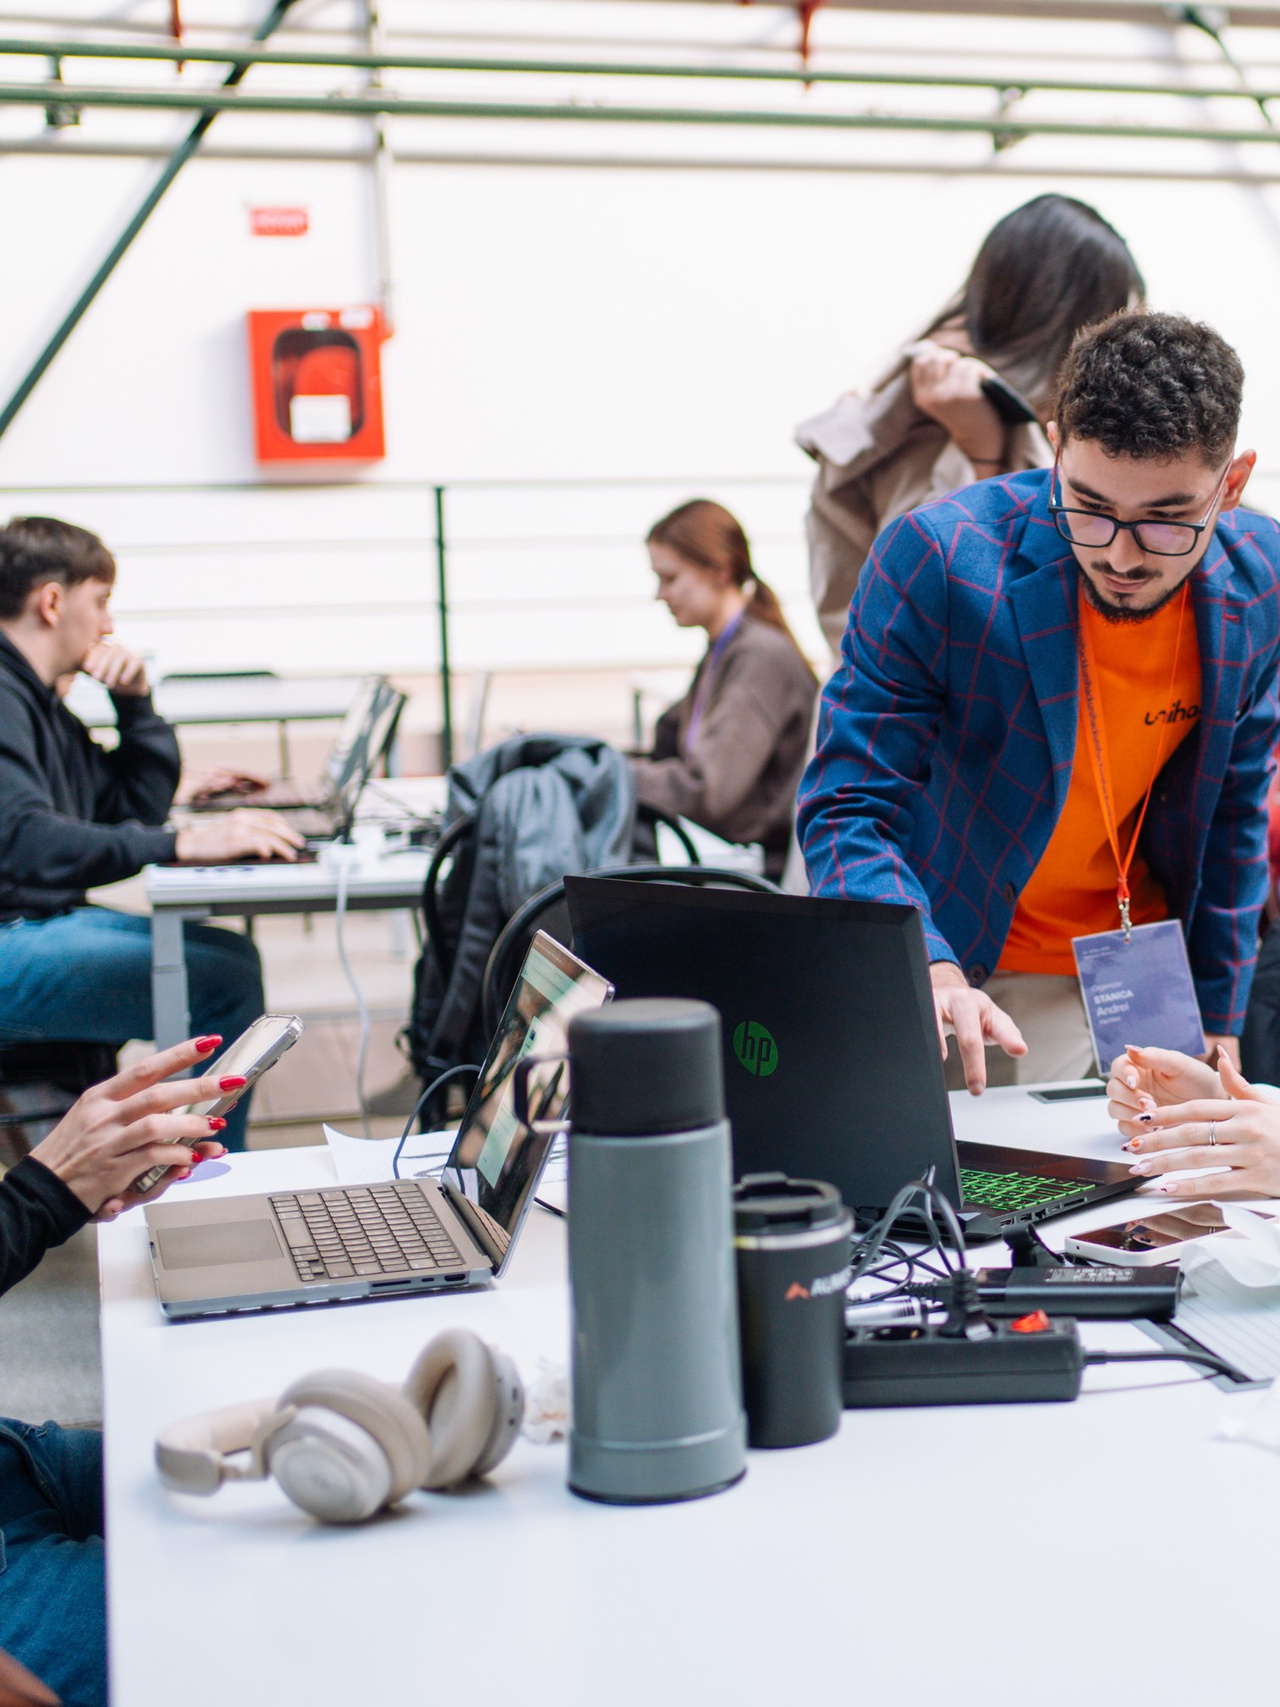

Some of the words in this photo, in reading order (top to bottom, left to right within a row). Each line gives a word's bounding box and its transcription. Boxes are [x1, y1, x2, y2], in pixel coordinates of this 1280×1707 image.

[1093, 989, 1135, 1004] STANICA
[1096, 1001, 1130, 1017] Andrei
[737, 1020, 775, 1077] hp
